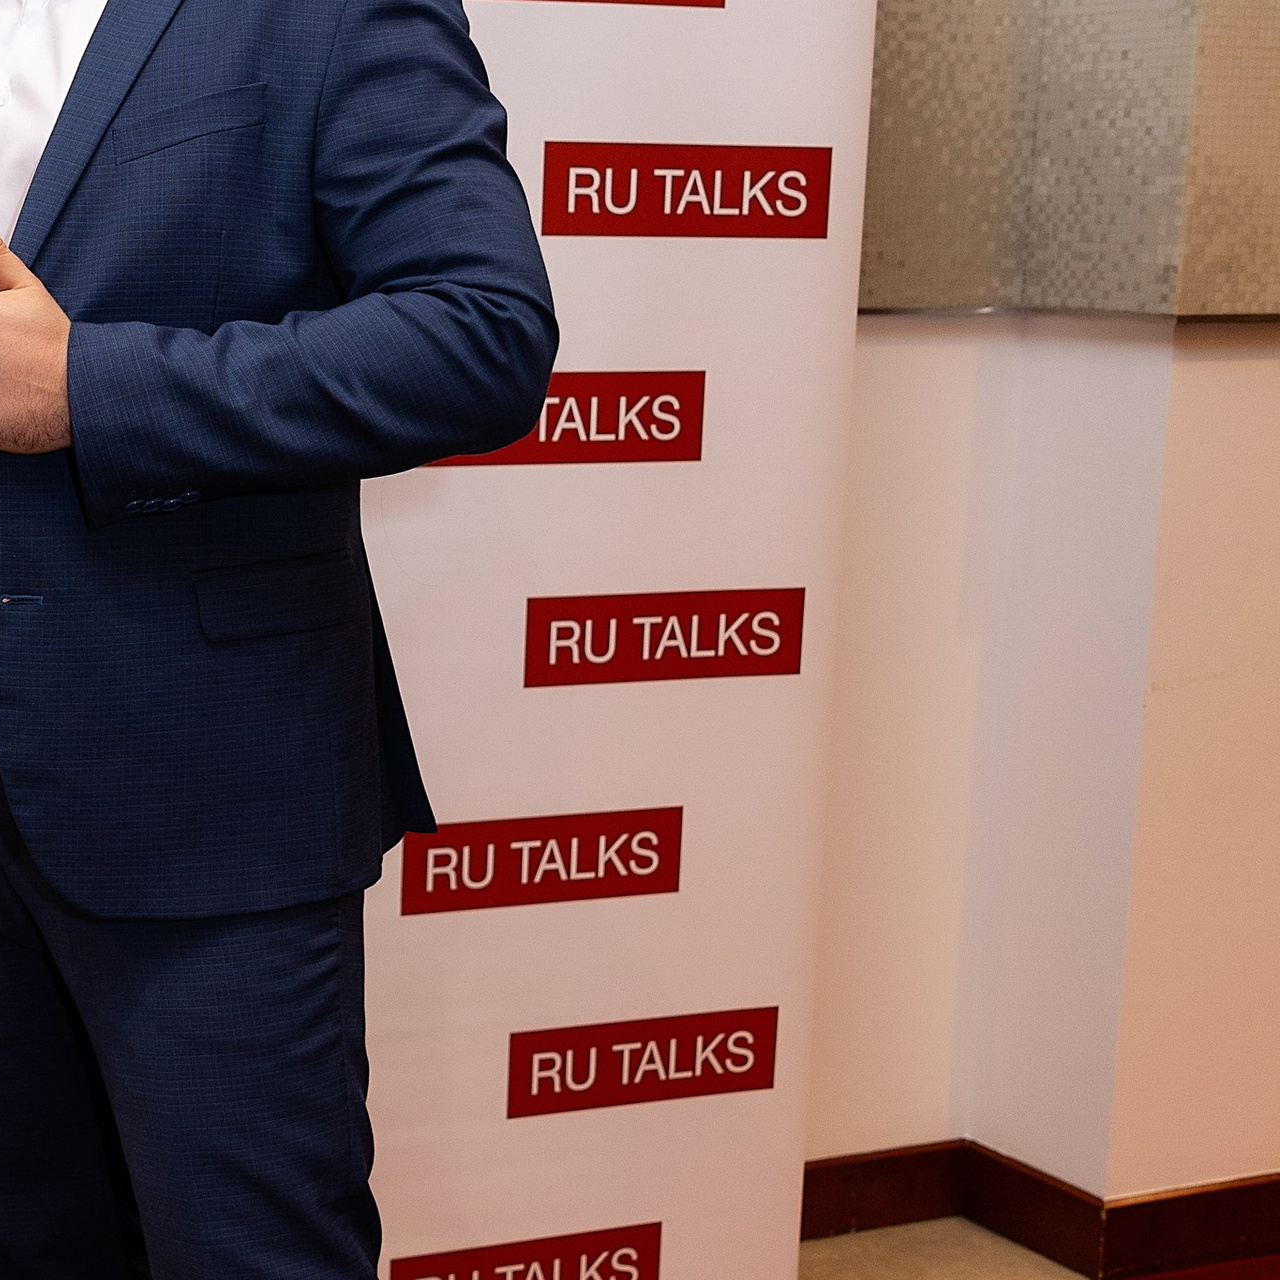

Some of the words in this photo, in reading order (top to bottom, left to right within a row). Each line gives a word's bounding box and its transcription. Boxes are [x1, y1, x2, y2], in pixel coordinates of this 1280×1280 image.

[567, 167, 638, 215] RU
[653, 168, 807, 217] TALKS
[538, 394, 681, 443] TALKS
[549, 618, 617, 665] RU
[632, 611, 781, 660] TALKS
[426, 843, 495, 892] RU
[510, 831, 659, 884] TALKS
[531, 1047, 597, 1095] RU
[612, 1031, 754, 1085] TALKS
